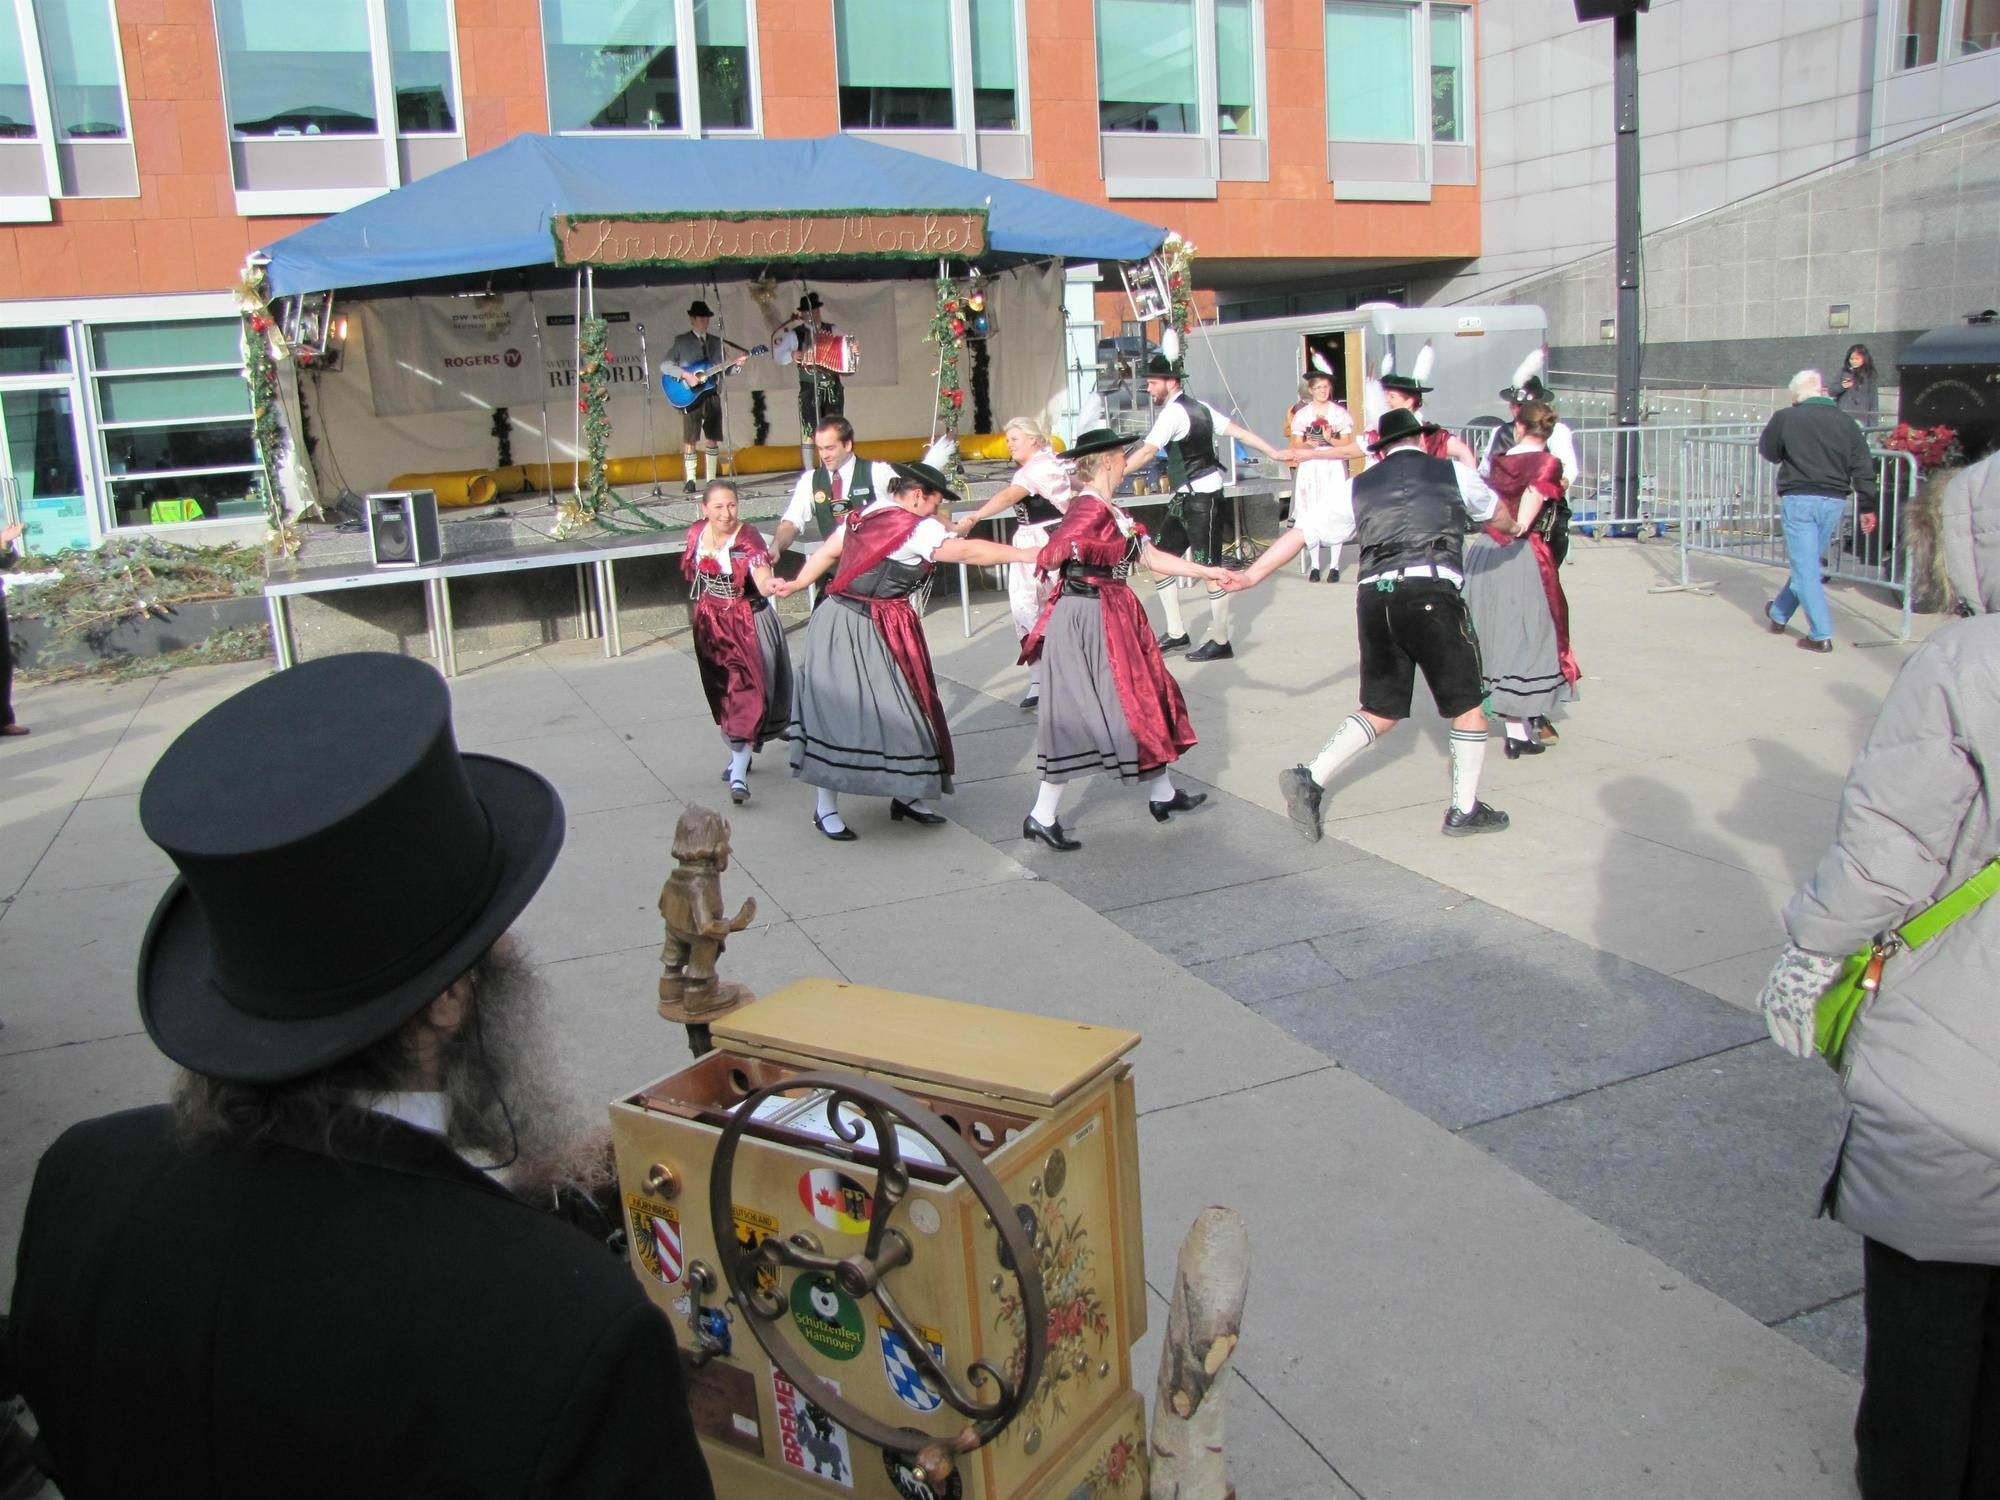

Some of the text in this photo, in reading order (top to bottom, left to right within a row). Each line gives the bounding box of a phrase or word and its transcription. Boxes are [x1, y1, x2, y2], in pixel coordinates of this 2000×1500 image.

[828, 213, 980, 254] Market
[444, 350, 521, 368] ROGERS TV
[733, 1207, 772, 1226] EUTSCHLAND
[806, 1327, 855, 1352] Hannover
